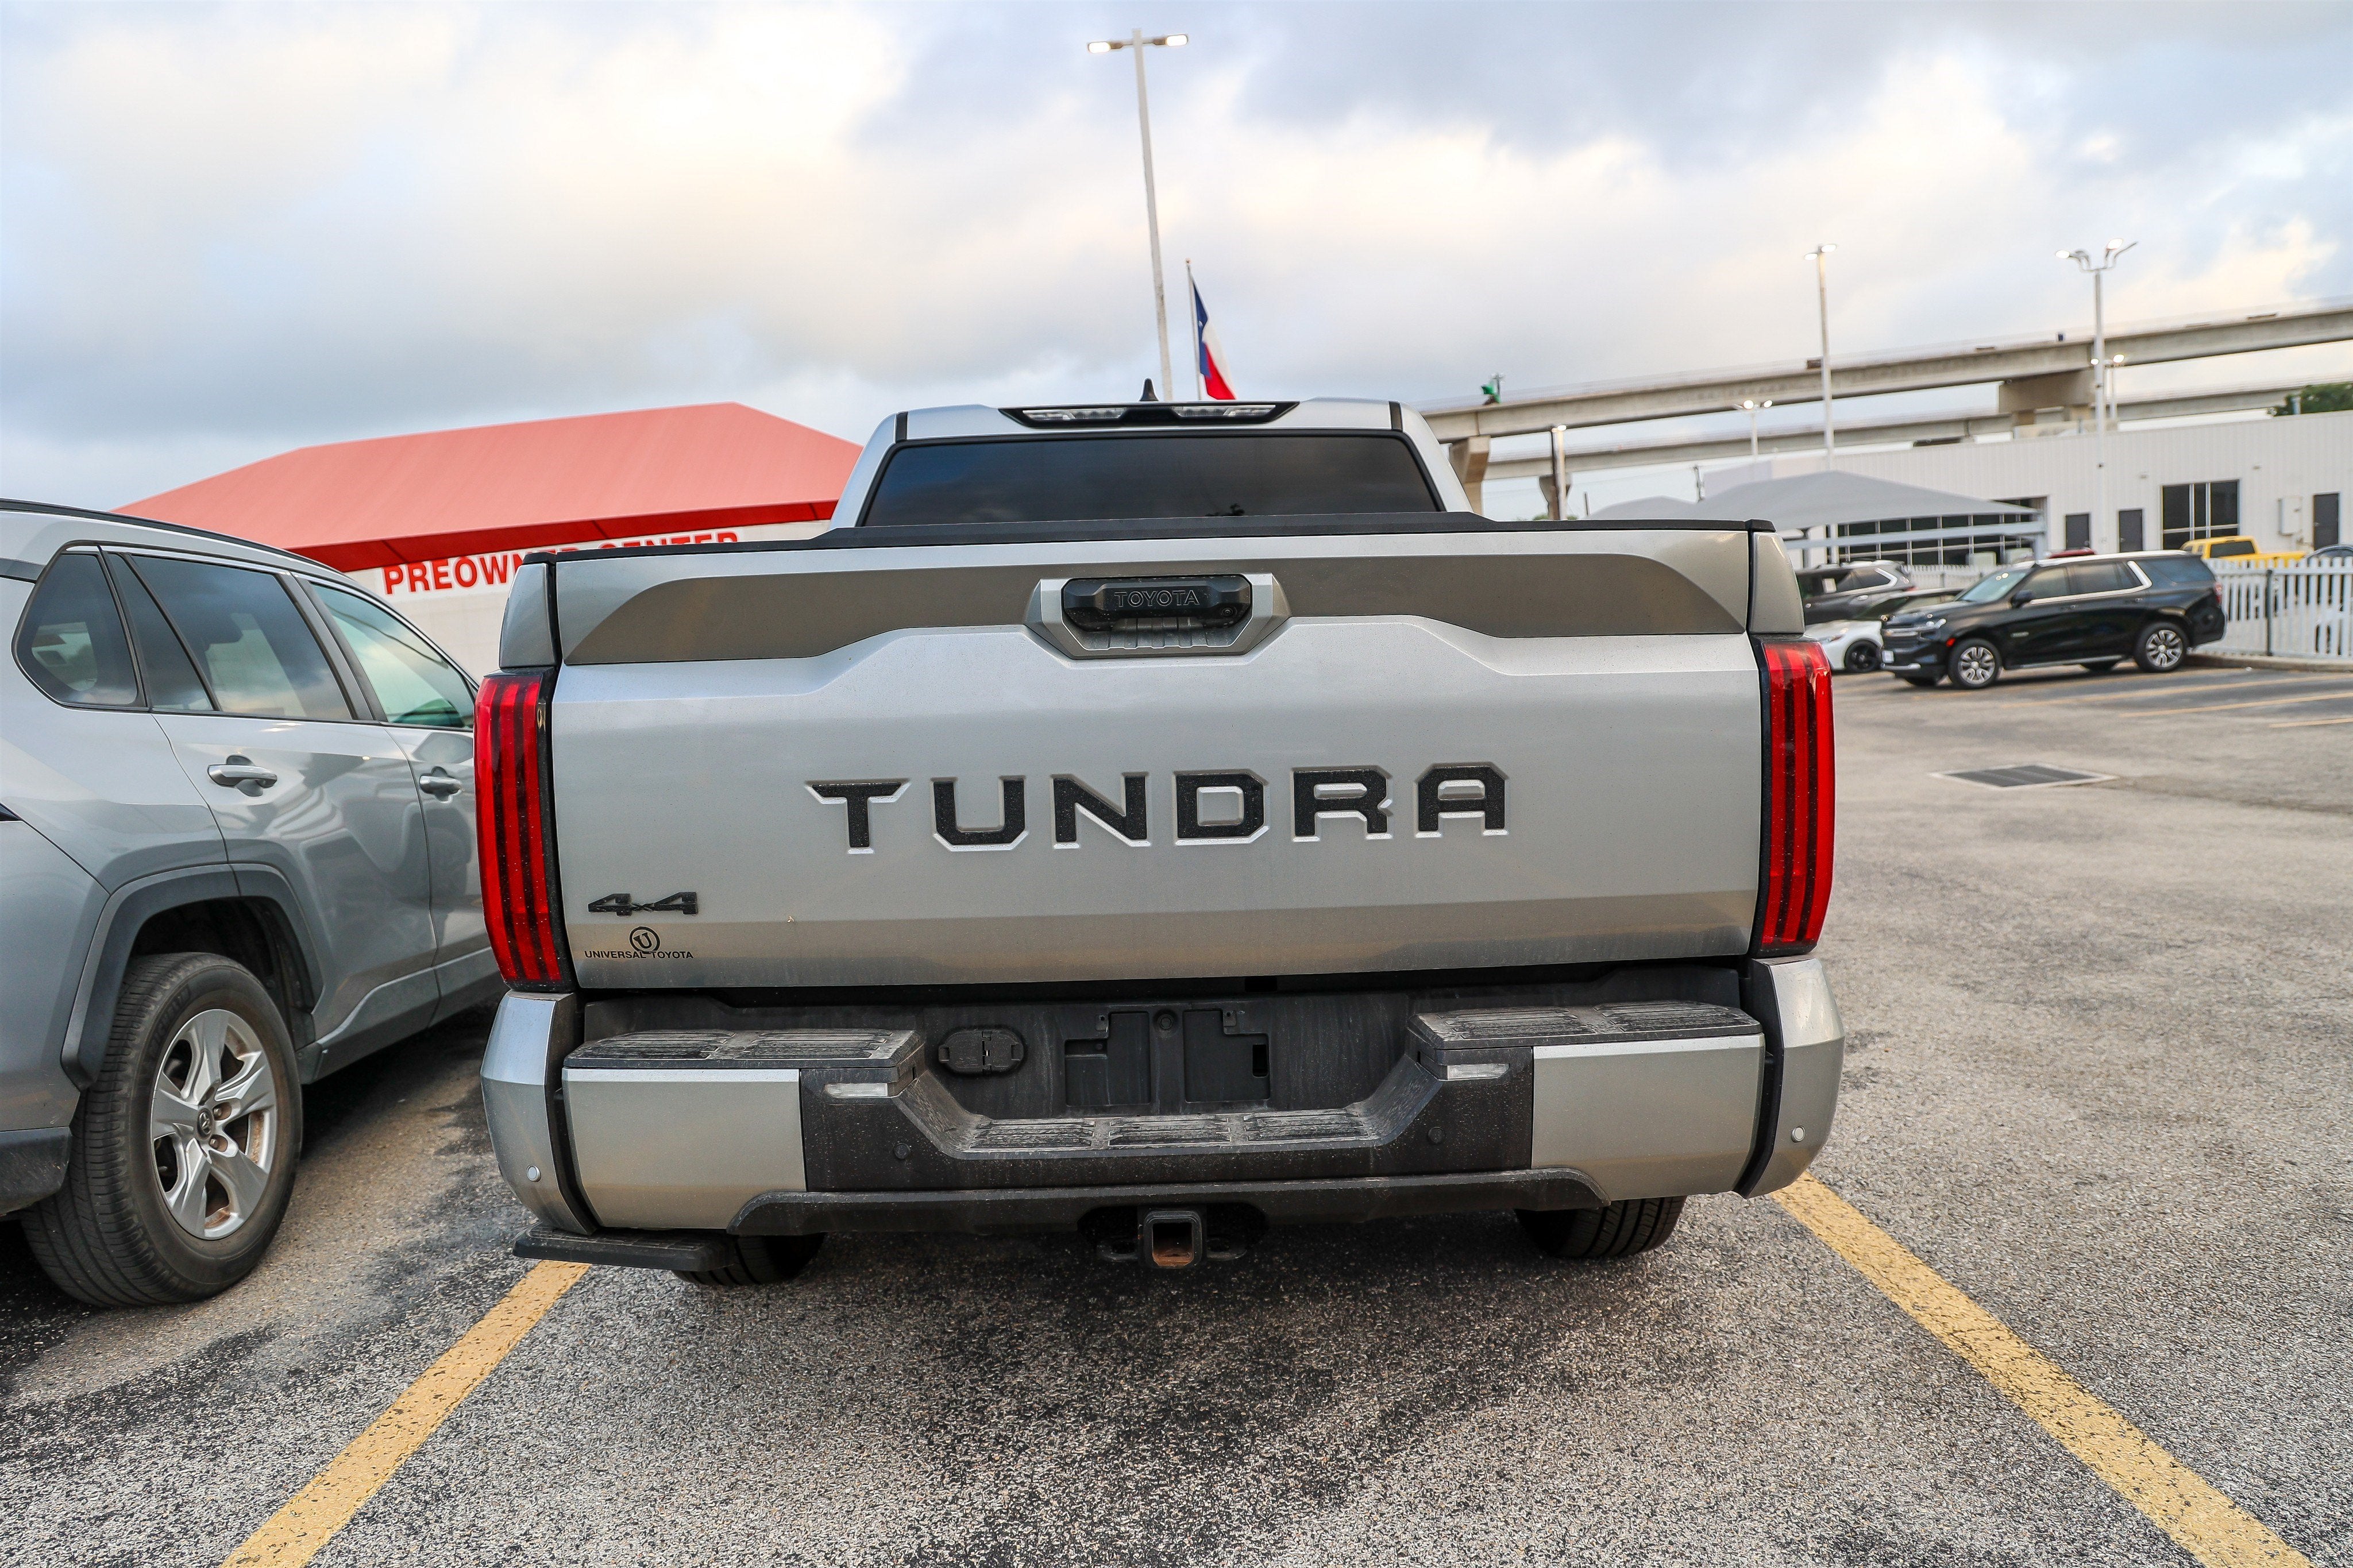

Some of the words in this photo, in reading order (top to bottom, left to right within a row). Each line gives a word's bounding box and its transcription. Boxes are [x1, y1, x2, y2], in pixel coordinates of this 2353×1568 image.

[383, 547, 578, 594] PREOW
[1114, 590, 1199, 607] TOYOTA
[805, 762, 1509, 855] TUNDRA
[584, 950, 647, 959] UNIVERSAL
[650, 951, 695, 959] TOYOTA
